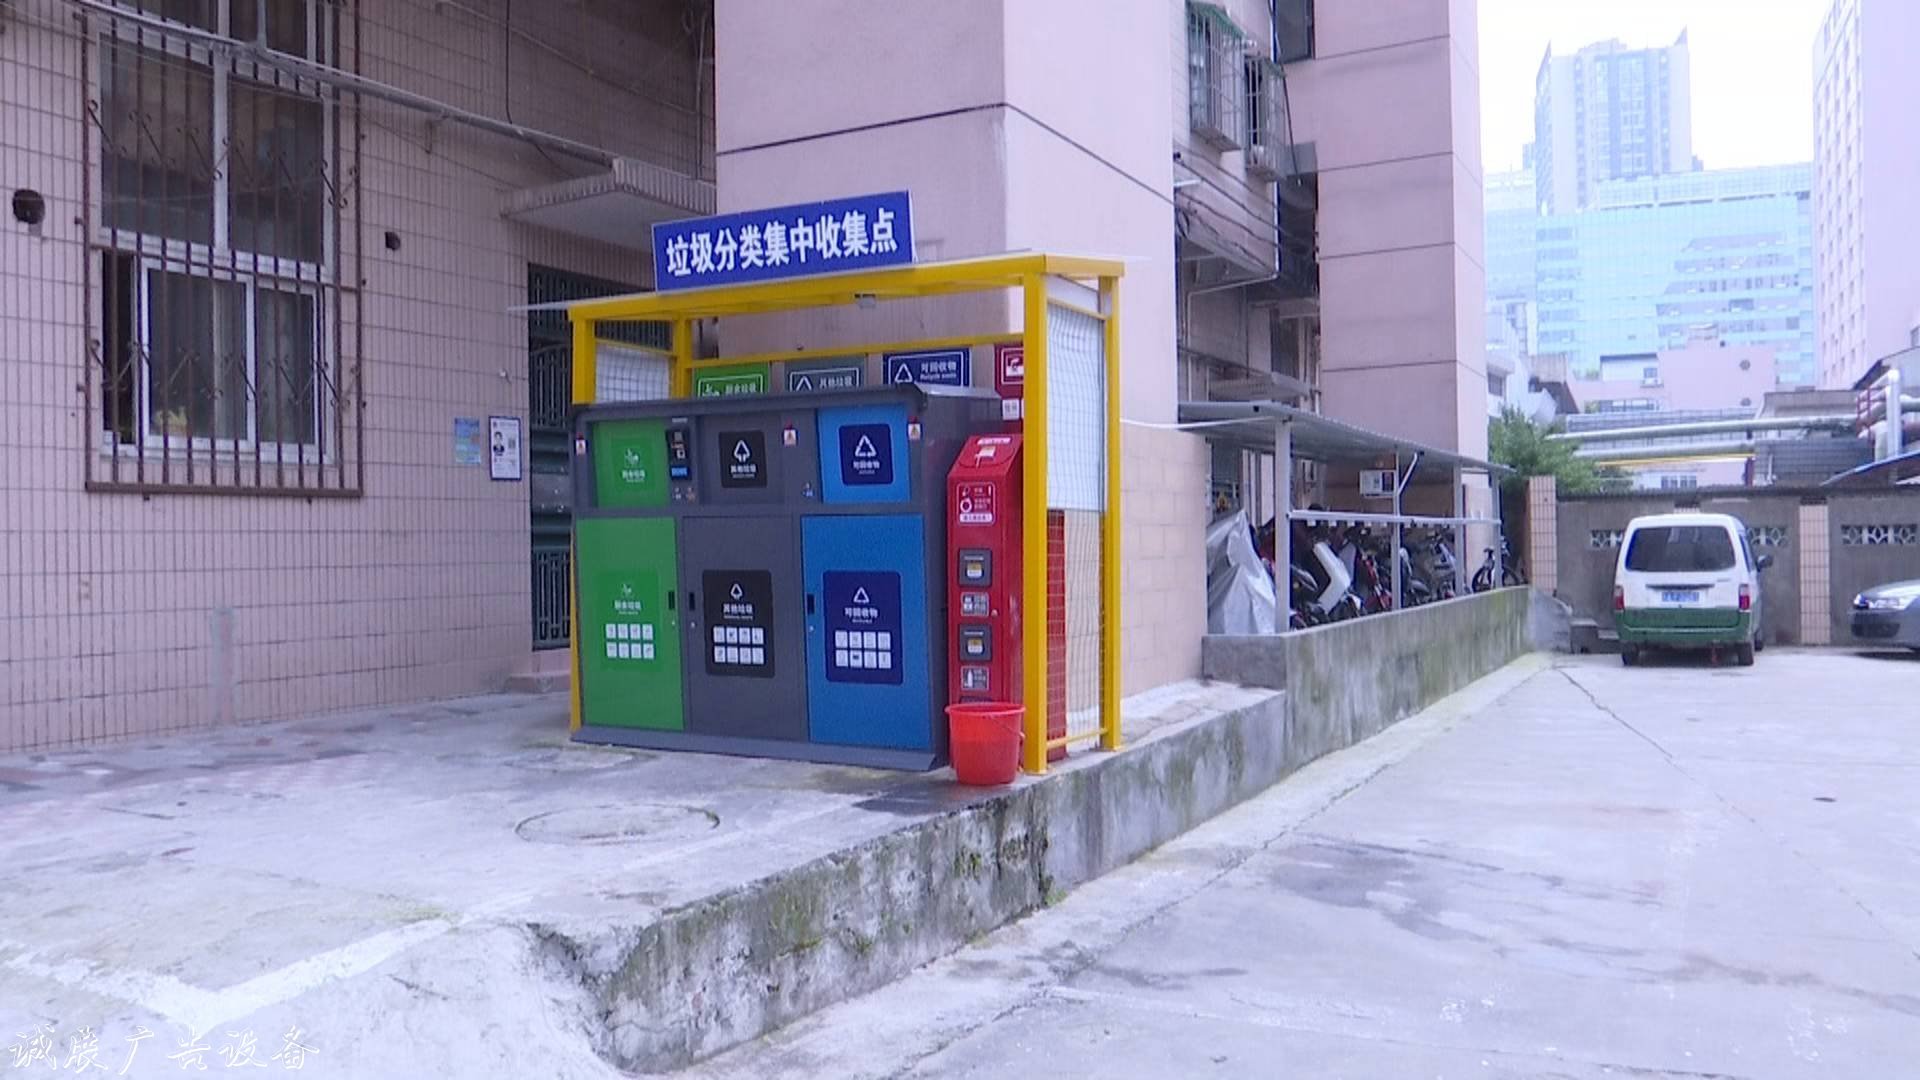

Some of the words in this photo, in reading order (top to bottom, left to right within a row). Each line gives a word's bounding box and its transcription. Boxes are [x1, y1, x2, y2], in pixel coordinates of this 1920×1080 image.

[666, 207, 898, 277] 垃圾分类集中收集点
